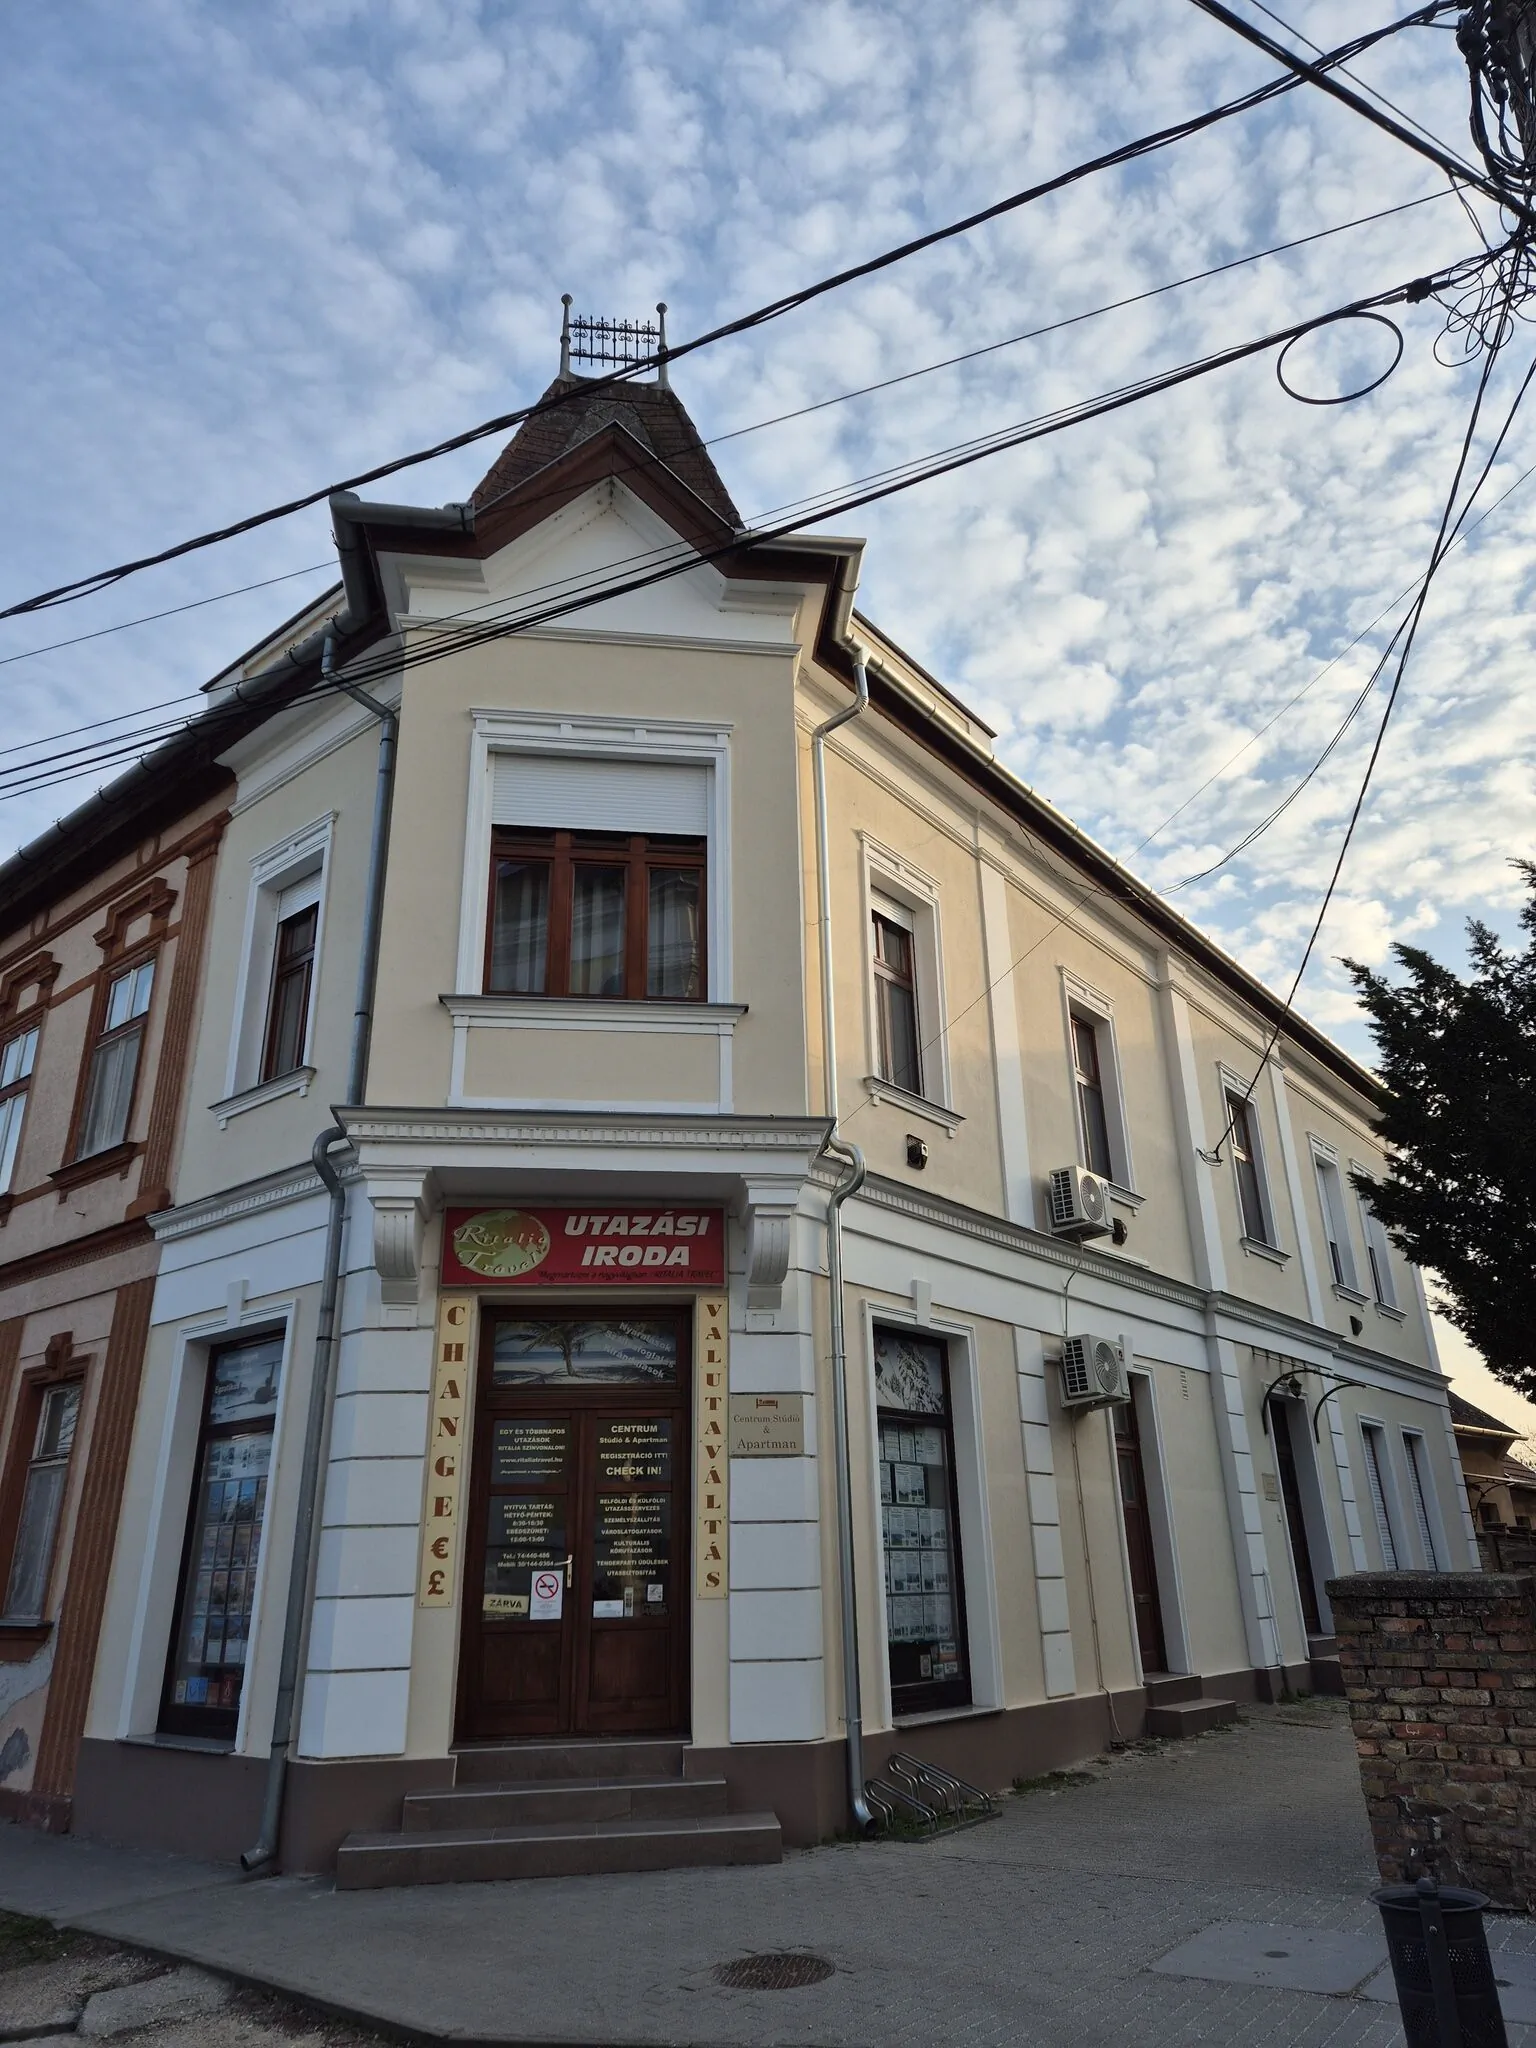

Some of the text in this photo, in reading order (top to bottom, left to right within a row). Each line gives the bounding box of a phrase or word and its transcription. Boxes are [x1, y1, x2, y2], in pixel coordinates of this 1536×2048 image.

[564, 1210, 710, 1236] UTAZÁSI
[453, 1224, 546, 1247] Ritalia
[580, 1245, 690, 1266] IRODA
[733, 1414, 770, 1423] Centrum
[611, 1425, 658, 1433] CENTRUM
[763, 1425, 770, 1434] &
[704, 1304, 723, 1588] VALUTAVÁLTÁS
[737, 1438, 796, 1451] Apartman
[600, 1452, 653, 1460] REGISZTRÁCIÓ
[606, 1466, 662, 1476] CHECK IN!
[489, 1596, 522, 1609] ZÁRVA
